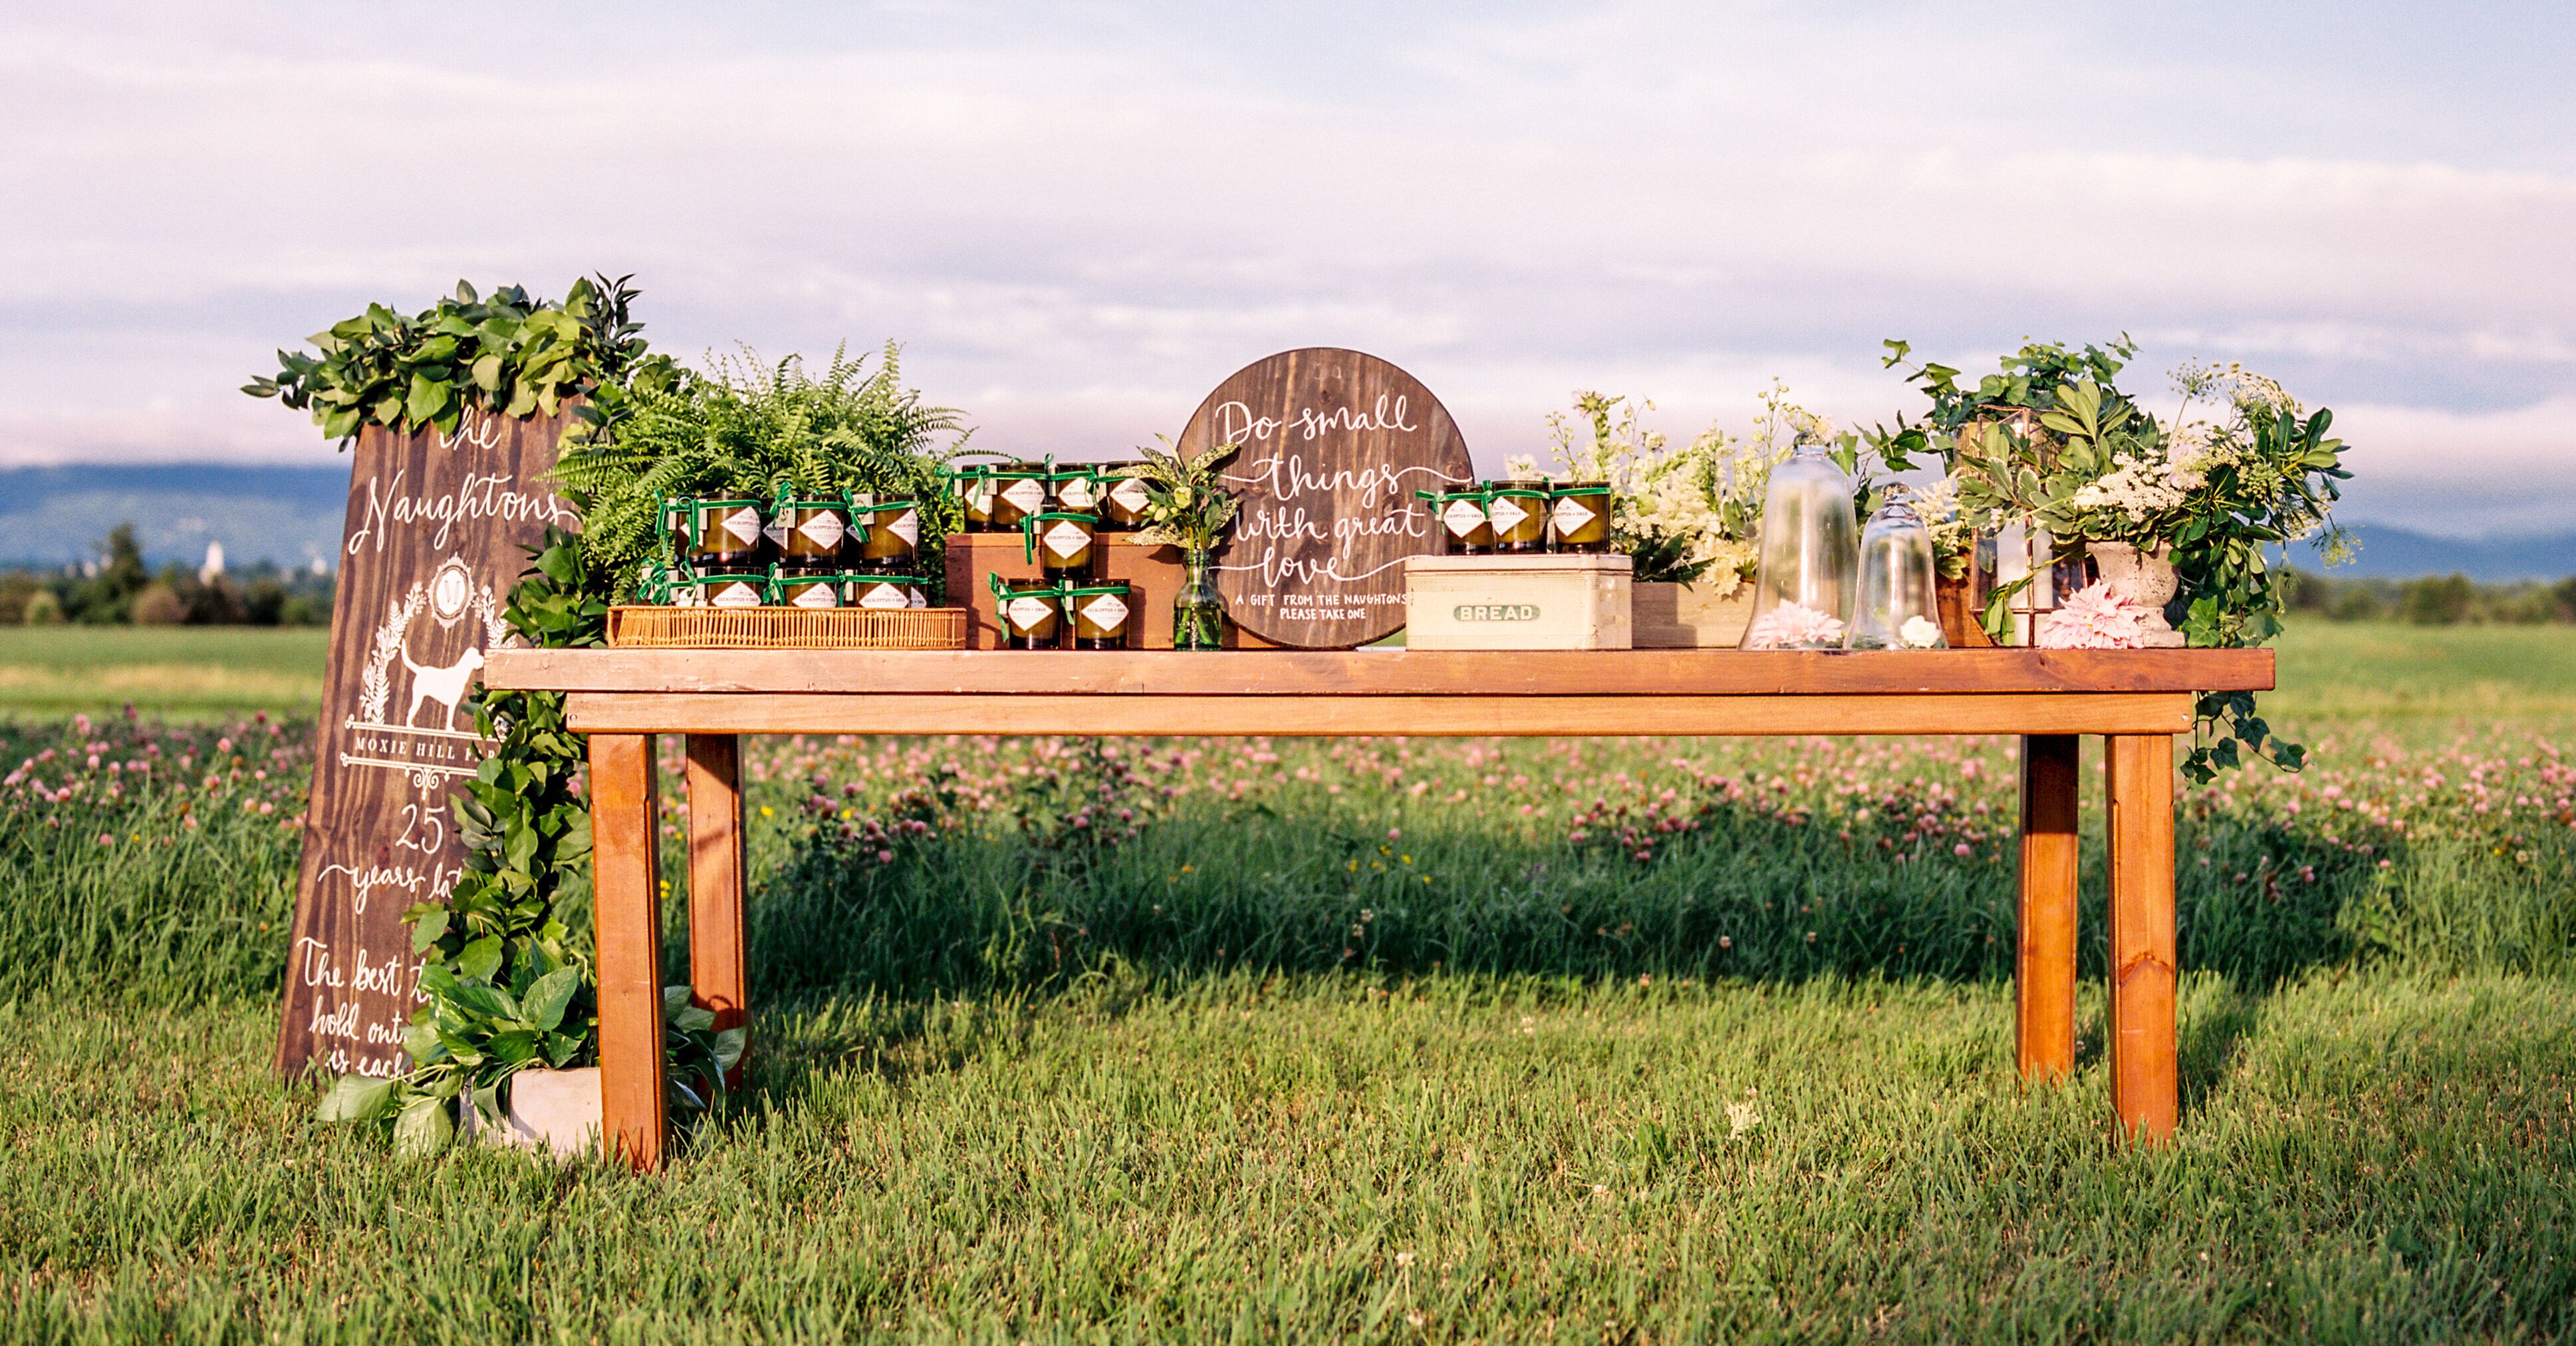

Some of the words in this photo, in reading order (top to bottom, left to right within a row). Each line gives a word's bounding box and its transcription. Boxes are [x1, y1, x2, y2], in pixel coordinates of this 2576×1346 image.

[1216, 401, 1282, 444] Do
[1289, 394, 1418, 440] small
[348, 469, 578, 554] Naughtons
[1235, 505, 1328, 541] with
[1334, 503, 1426, 559] great
[1235, 595, 1243, 605] A
[1250, 594, 1275, 606] GIFT
[1283, 594, 1313, 606] FROM
[1317, 594, 1340, 606] THE
[1280, 607, 1317, 620] PLEASE
[1319, 608, 1345, 620] TAKE
[1347, 608, 1366, 619] ONE
[1460, 606, 1532, 620] BREAD
[355, 736, 407, 755] MOXIE
[416, 742, 455, 759] HILL
[396, 803, 446, 855] 25
[318, 864, 426, 914] years
[297, 936, 344, 987] The
[351, 948, 402, 997] best
[309, 995, 360, 1041] hold
[325, 1043, 350, 1074] is
